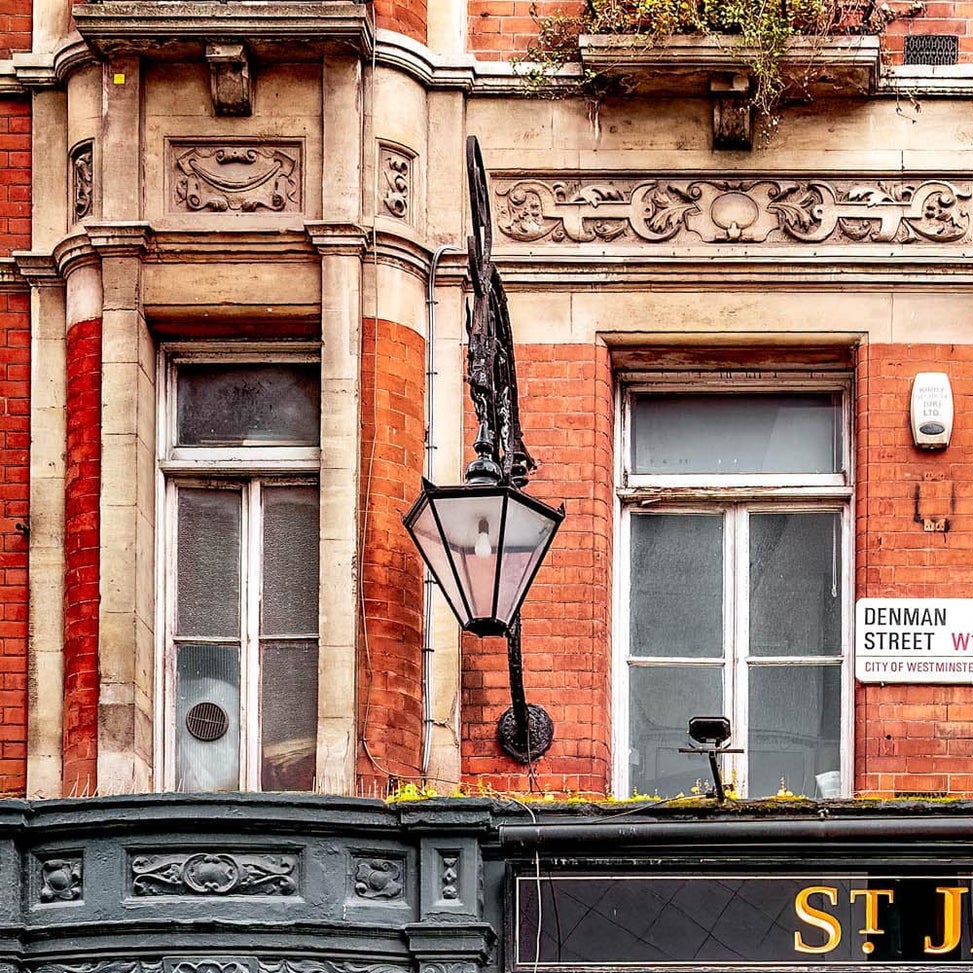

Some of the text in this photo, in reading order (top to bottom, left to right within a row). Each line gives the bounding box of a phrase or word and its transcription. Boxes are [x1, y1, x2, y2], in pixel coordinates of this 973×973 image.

[864, 607, 947, 626] DENMAN
[864, 632, 935, 650] STREET
[865, 661, 888, 672] CITY
[891, 661, 904, 672] OF
